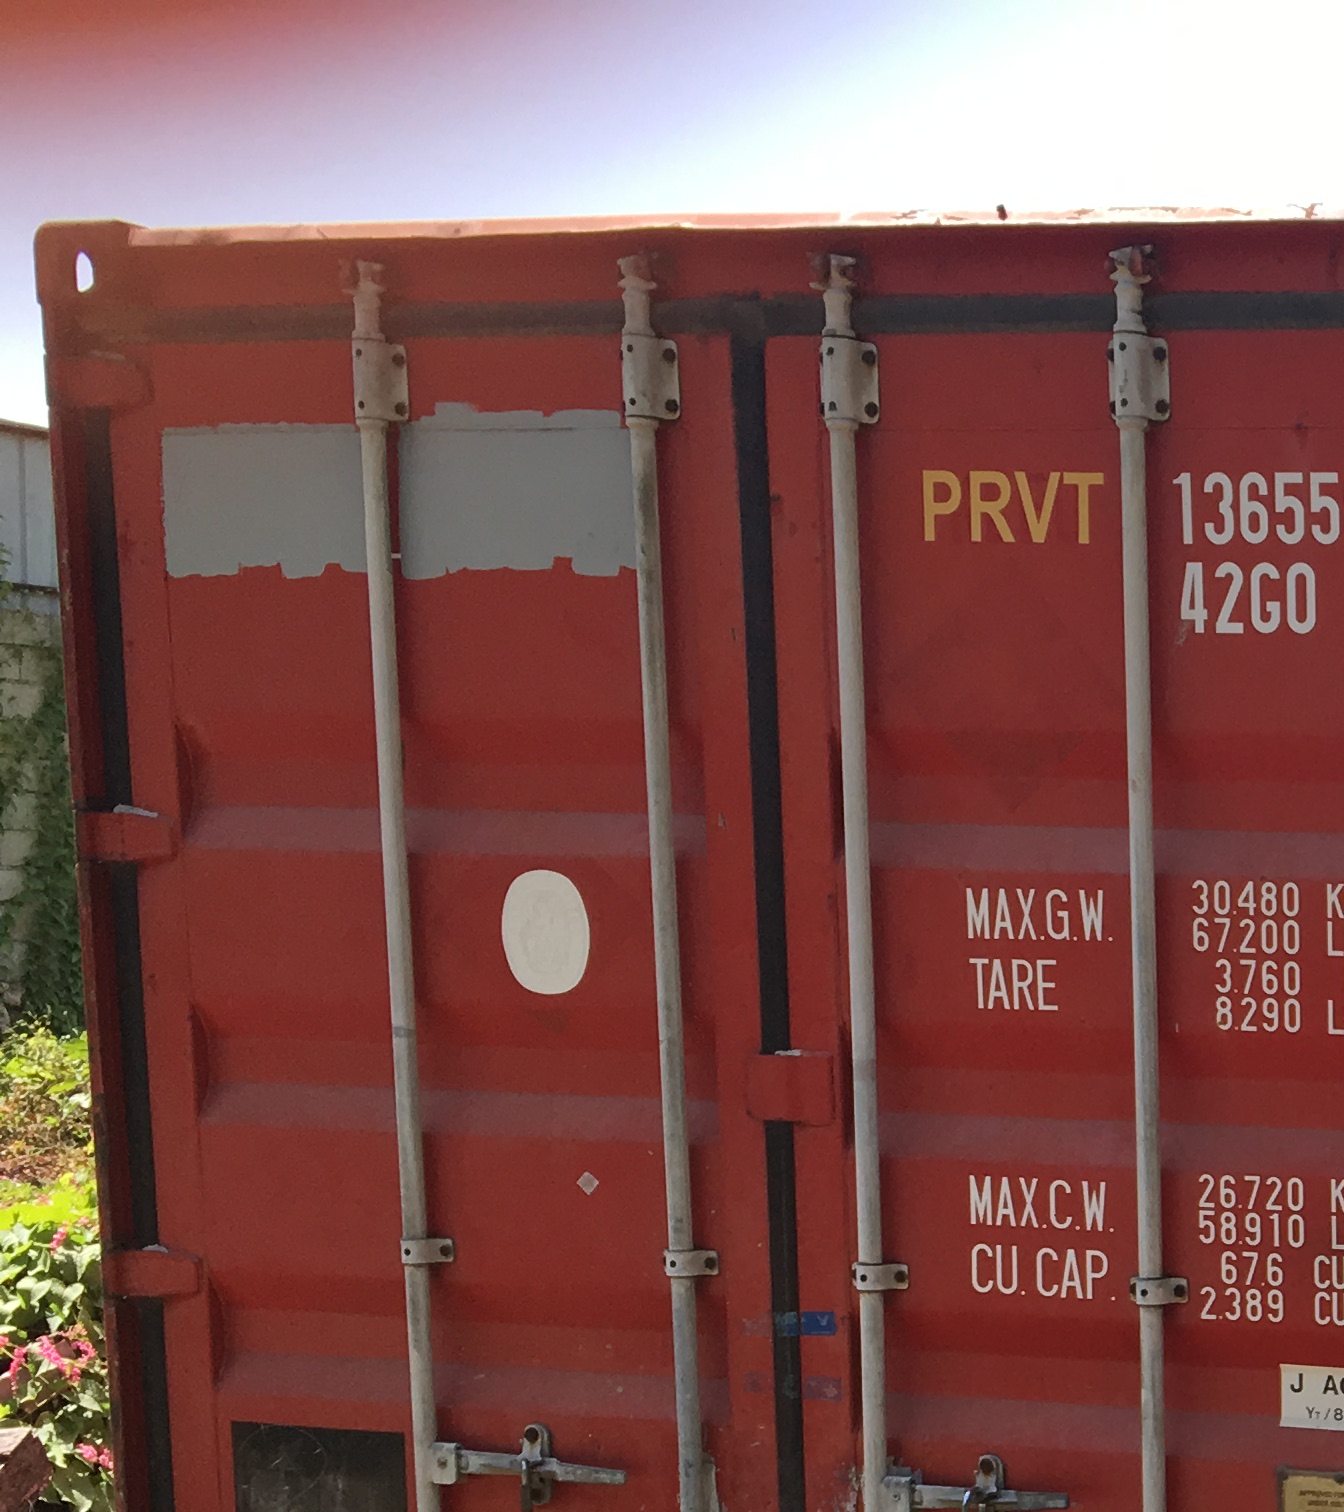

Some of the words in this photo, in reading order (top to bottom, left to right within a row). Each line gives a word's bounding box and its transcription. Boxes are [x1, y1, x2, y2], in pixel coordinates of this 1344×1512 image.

[922, 470, 1104, 545] PRVT
[969, 958, 1059, 1011] TARE
[1290, 1372, 1304, 1393] J
